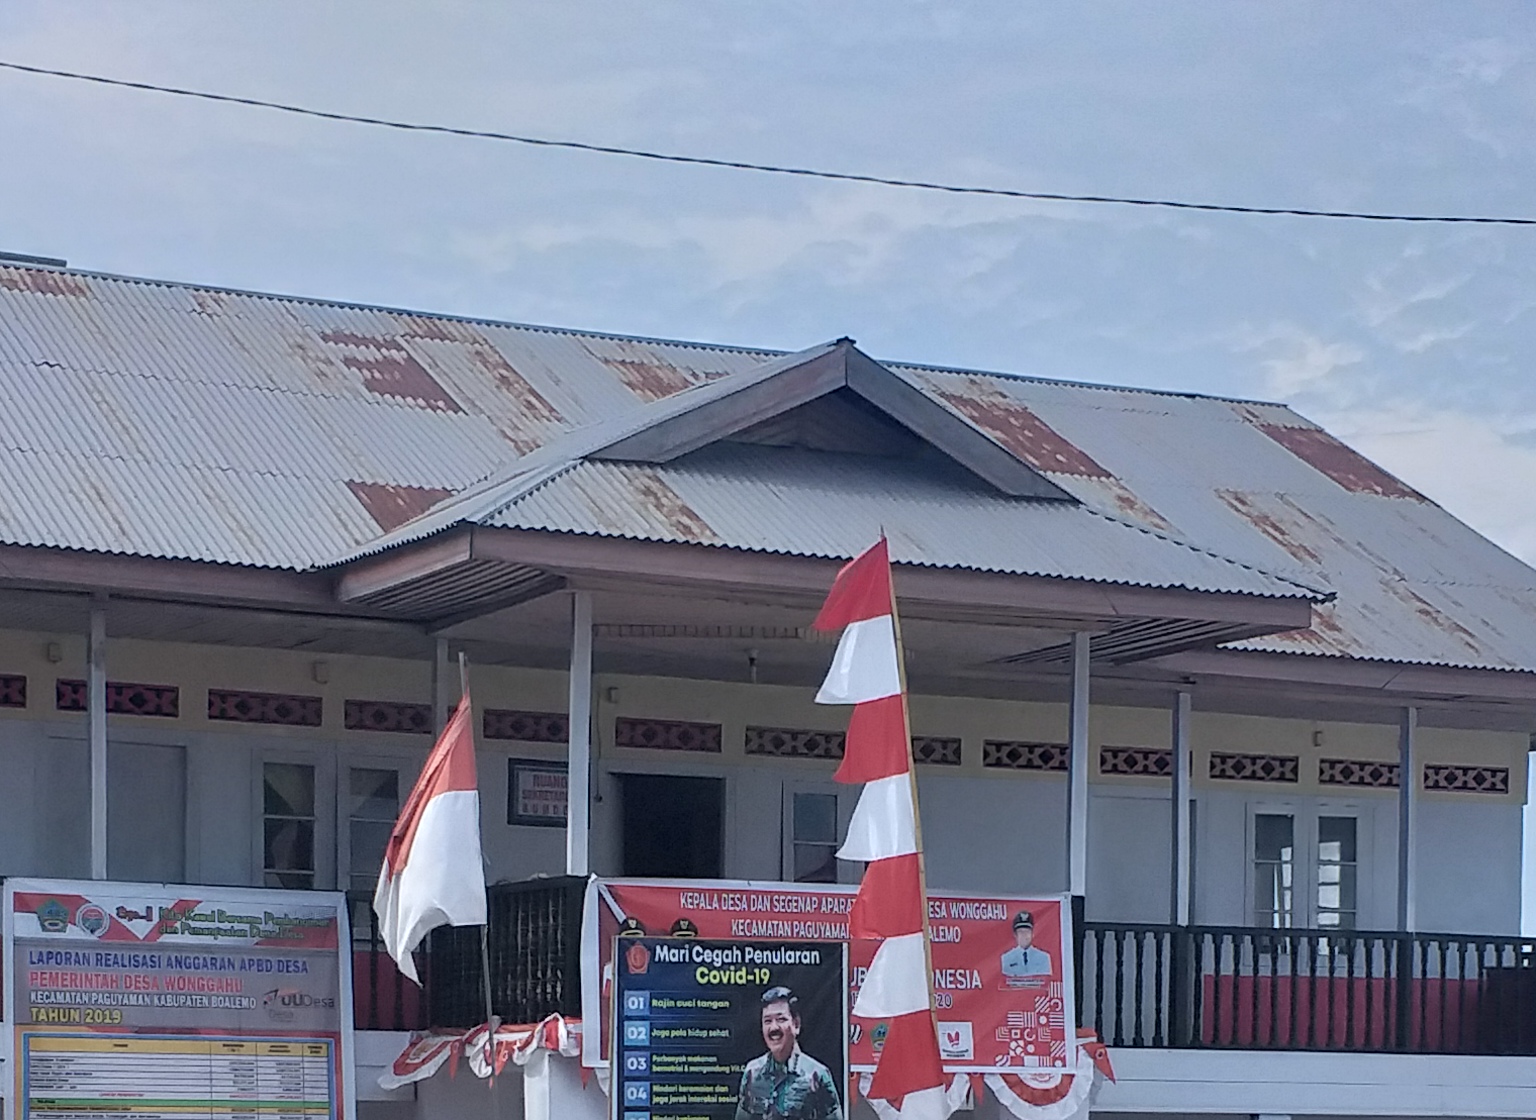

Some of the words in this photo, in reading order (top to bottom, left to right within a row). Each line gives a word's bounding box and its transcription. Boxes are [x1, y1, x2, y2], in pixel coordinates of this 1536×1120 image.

[680, 892, 720, 909] KEPALA
[721, 893, 747, 911] DESA
[750, 894, 770, 912] DAN
[773, 896, 818, 914] SEGENAP
[927, 902, 948, 918] ESA
[950, 903, 1008, 920] WONGGAHU
[731, 919, 791, 937] KECAMATAN
[929, 926, 962, 943] ALEMO
[29, 950, 92, 967] LAPORAN
[95, 952, 162, 969] REALISASI
[166, 954, 236, 972] ANGGARAN
[239, 957, 273, 973] APBD
[277, 958, 309, 974] DESA
[654, 944, 690, 963] Mari
[691, 945, 742, 967] Cegah
[744, 946, 820, 965] Penularan
[29, 971, 120, 989] PEMERINTAH
[123, 974, 160, 991] DESA
[164, 975, 243, 993] WONGGAHU
[695, 966, 771, 985] Covid-19
[30, 990, 91, 1004] KECAMATAN
[91, 992, 151, 1006] PAGUYAMAN
[154, 993, 210, 1009] KABUPATEN
[211, 995, 257, 1010] BOALEMO
[627, 996, 644, 1010] 01
[30, 1007, 81, 1023] TAHUN
[85, 1008, 123, 1024] 2019
[627, 1026, 646, 1040] 02
[627, 1056, 647, 1070] 03
[627, 1086, 647, 1100] 04
